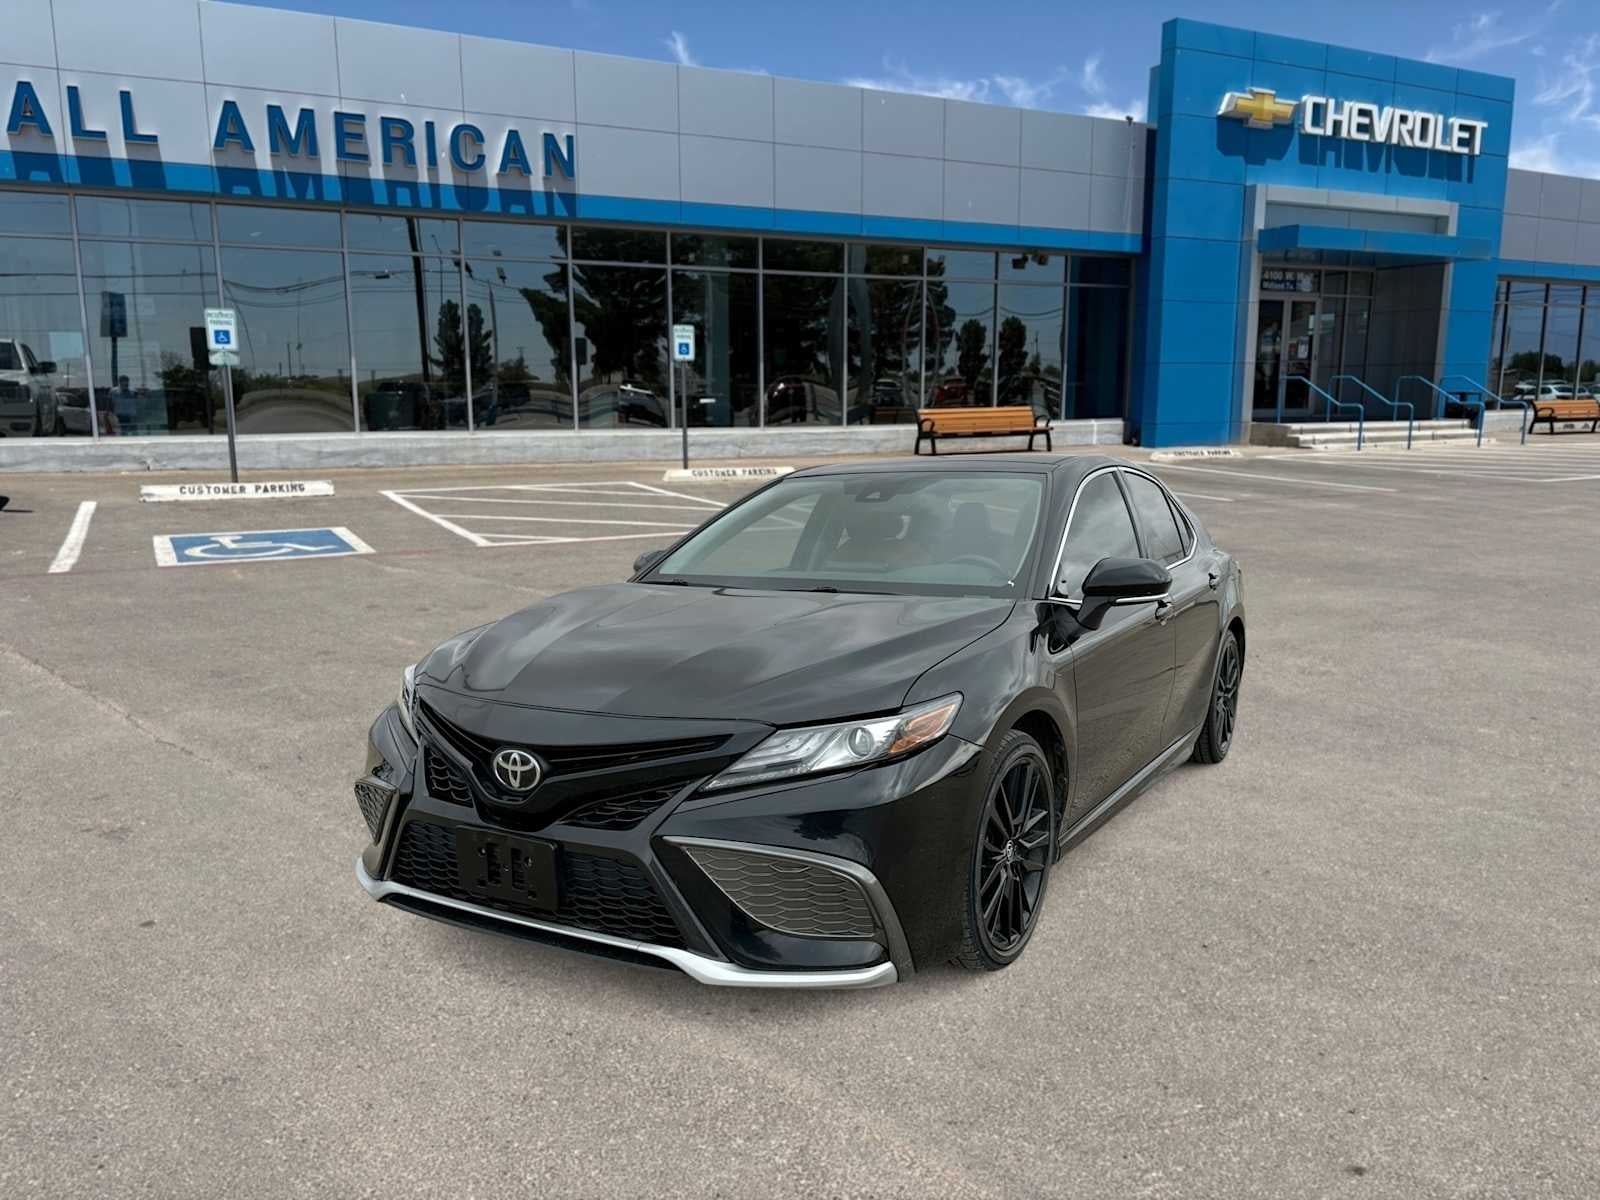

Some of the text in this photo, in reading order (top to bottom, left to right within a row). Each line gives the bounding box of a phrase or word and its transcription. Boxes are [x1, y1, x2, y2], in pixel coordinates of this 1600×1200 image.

[7, 80, 575, 179] ALL AMERICAN
[1302, 94, 1488, 155] CHEVROLET
[179, 483, 306, 495] CUSTOMER PARKING
[691, 469, 737, 477] CUSTOMER
